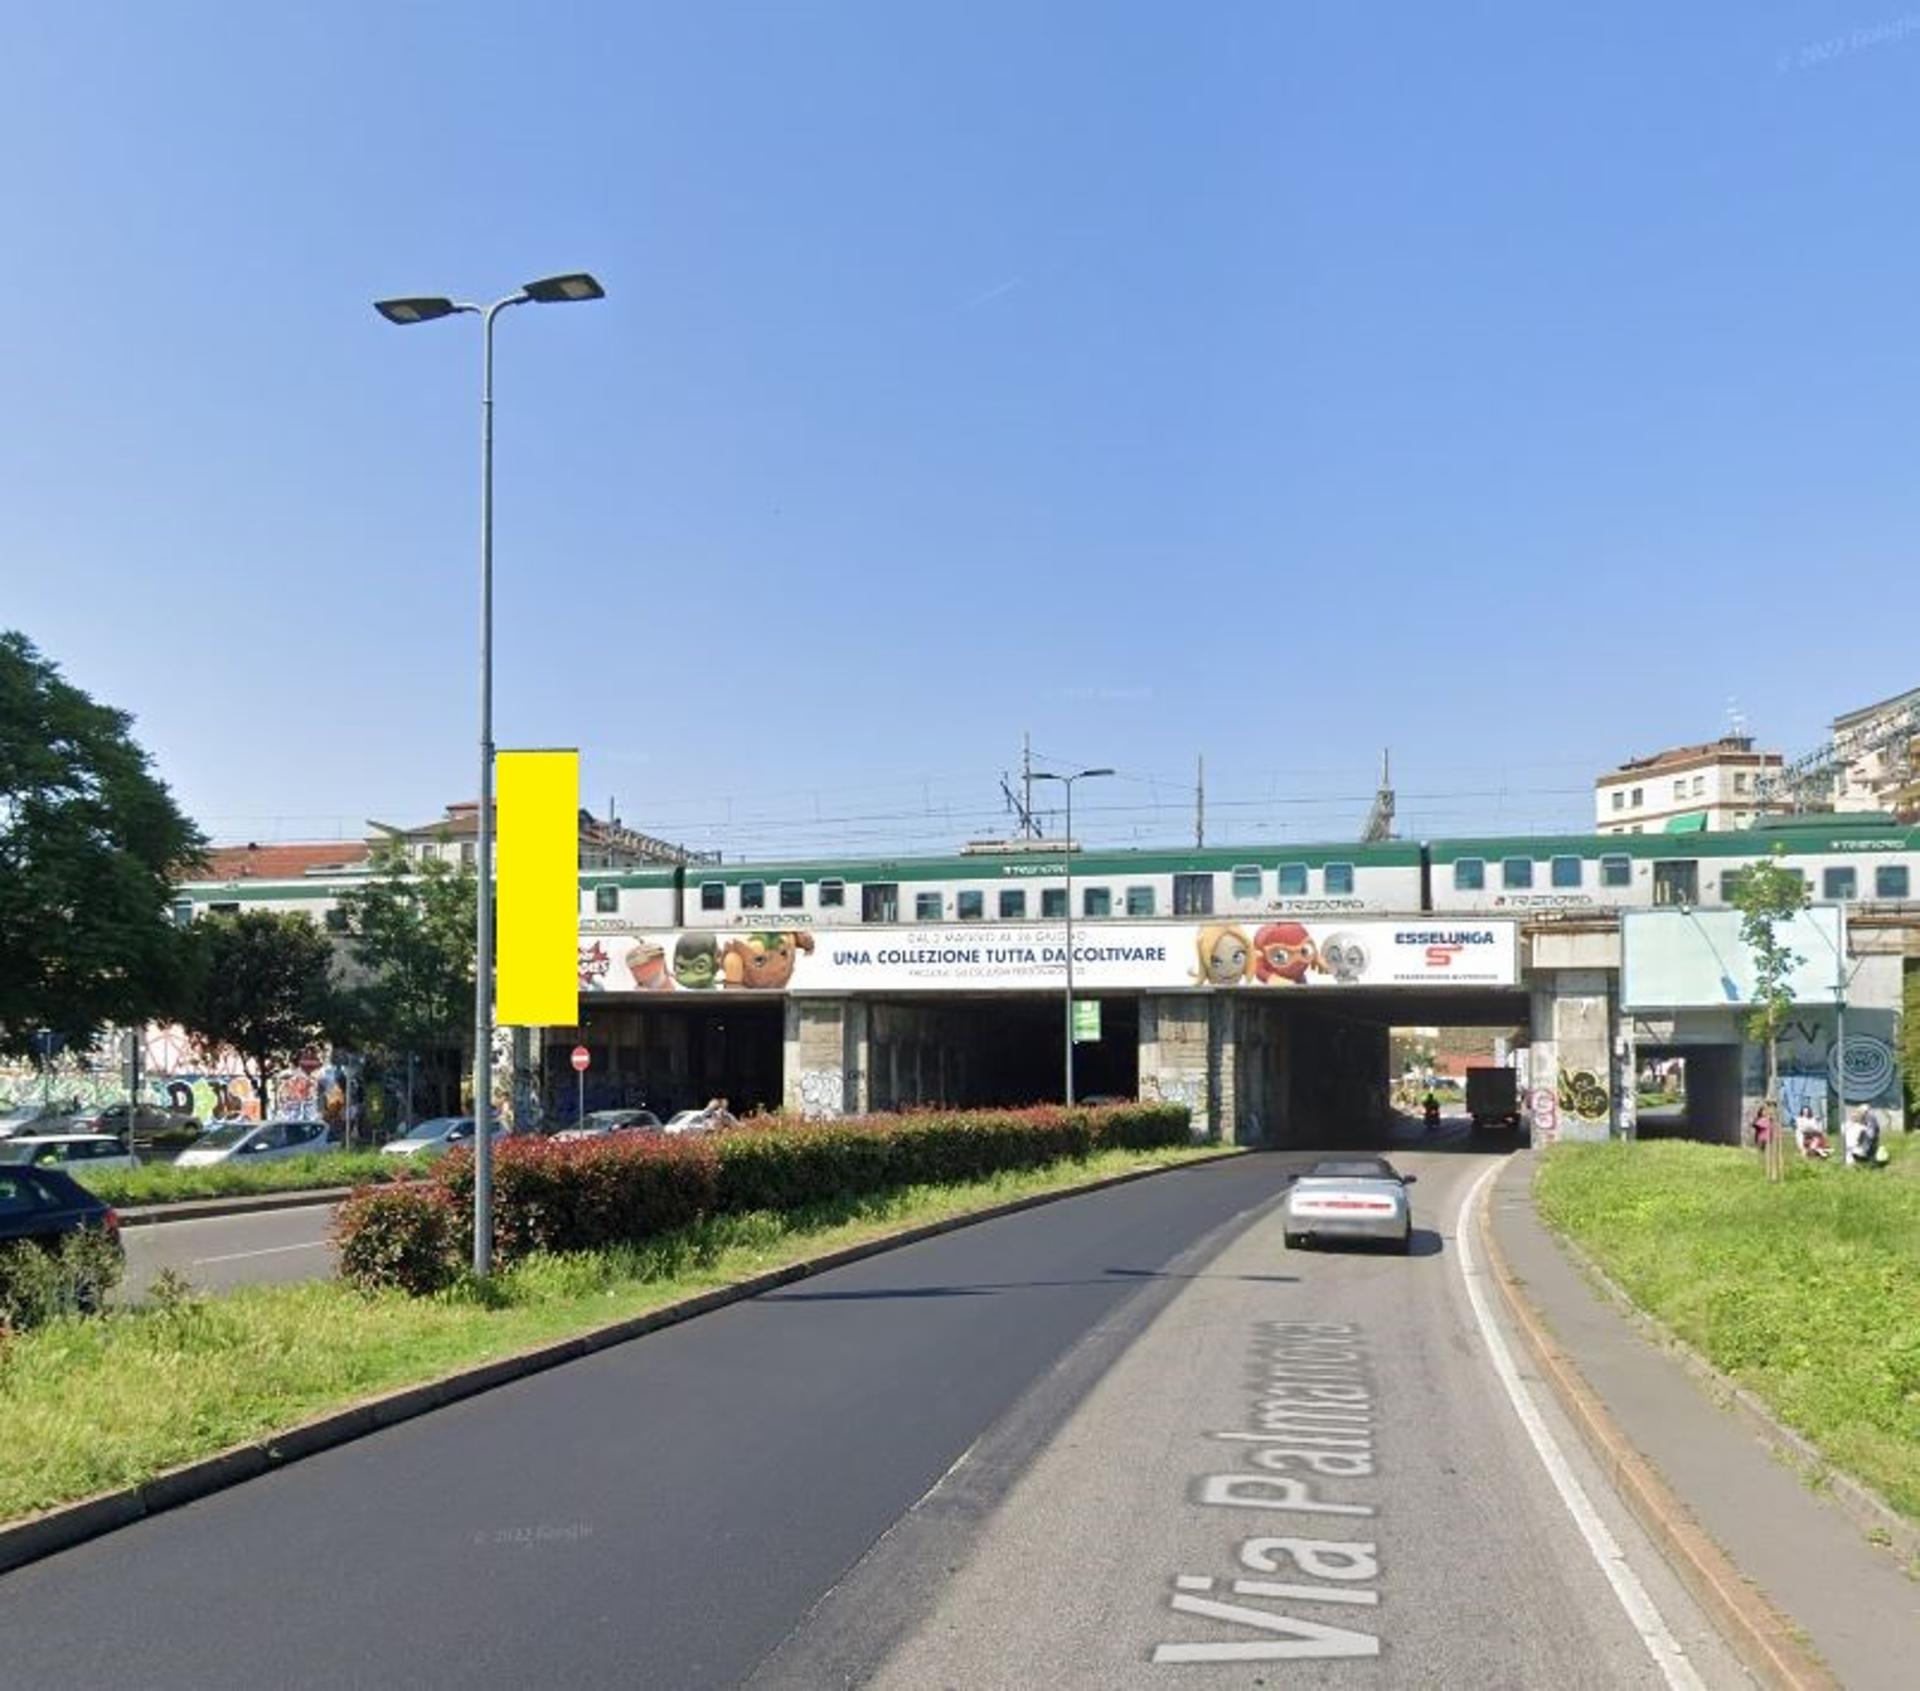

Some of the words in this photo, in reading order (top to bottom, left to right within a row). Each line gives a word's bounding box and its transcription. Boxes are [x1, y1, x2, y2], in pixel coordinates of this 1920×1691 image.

[1394, 931, 1495, 945] ESSELUNGA
[832, 949, 872, 966] UNA
[877, 948, 980, 965] COLLEZIONE
[986, 947, 1036, 964] TUTTA
[1042, 947, 1067, 963] DA
[1074, 946, 1167, 963] COLTIVARE
